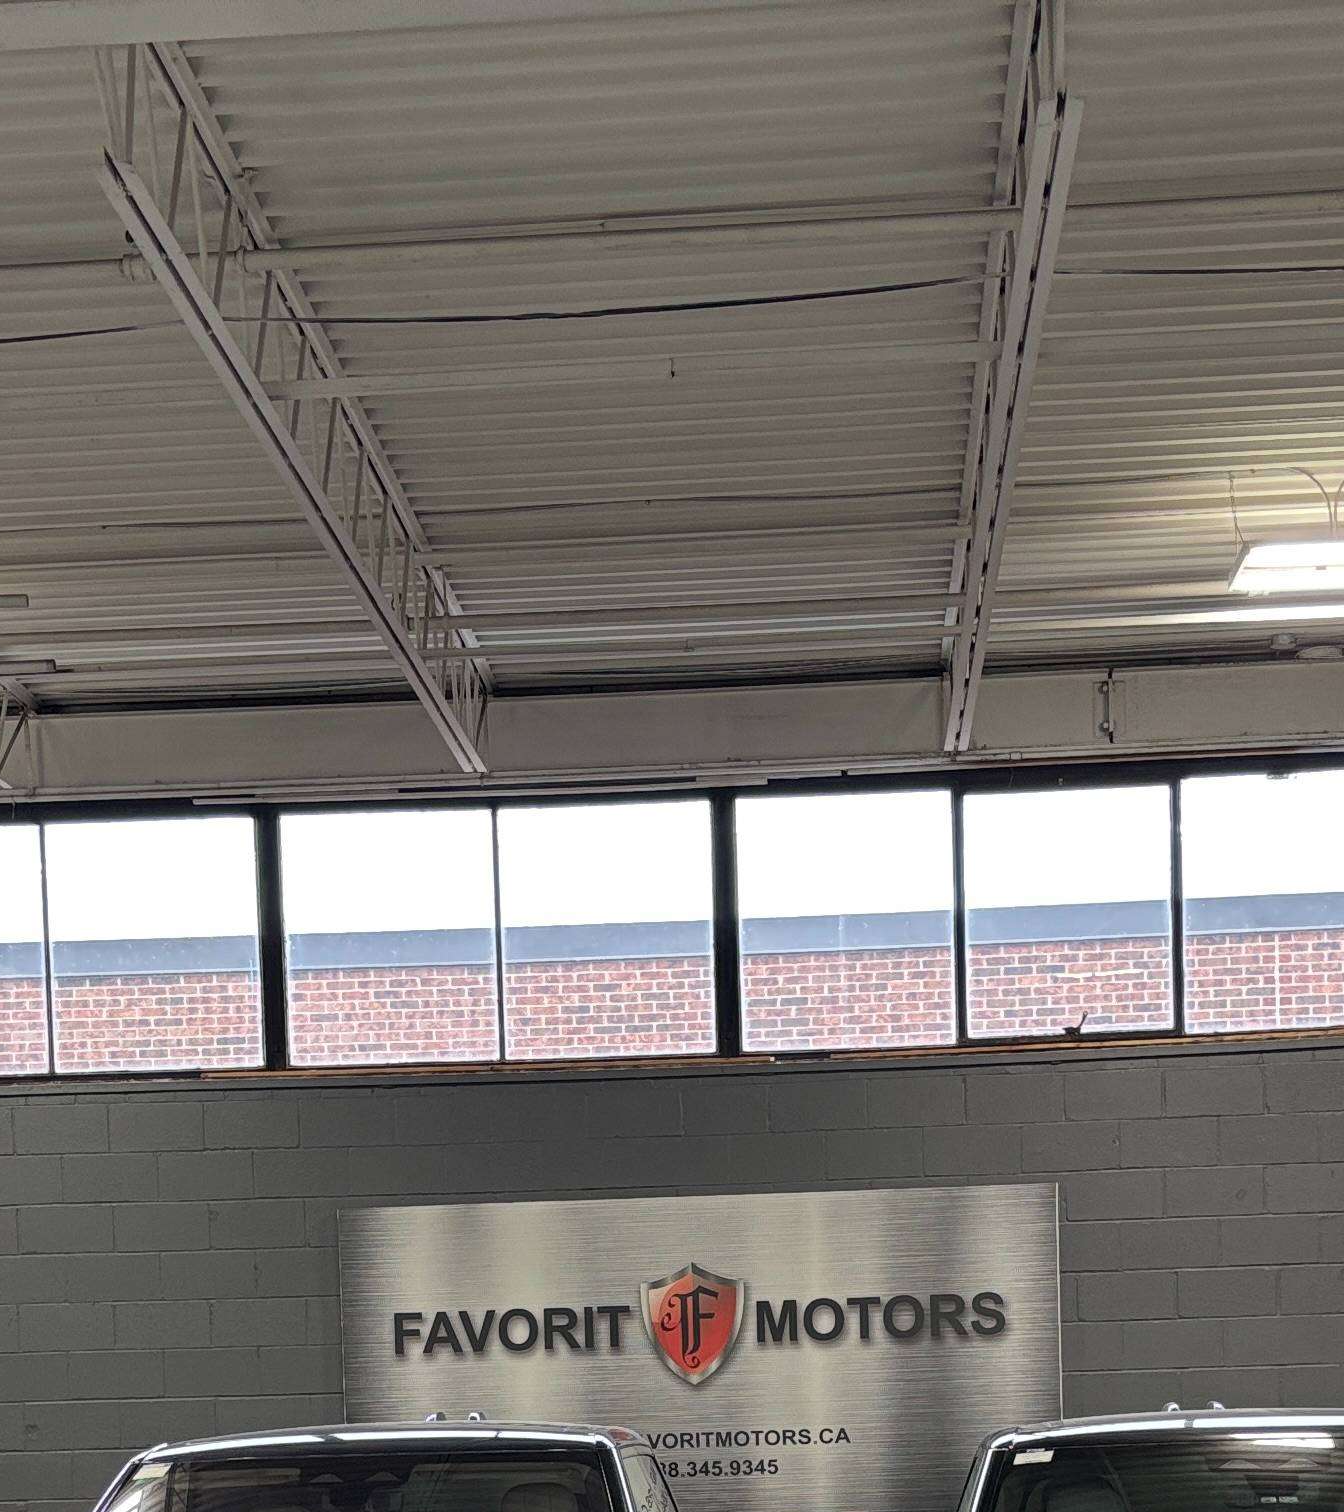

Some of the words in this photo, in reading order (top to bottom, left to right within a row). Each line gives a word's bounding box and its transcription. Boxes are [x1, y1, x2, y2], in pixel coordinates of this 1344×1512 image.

[393, 1304, 630, 1355] FAVORIT
[757, 1291, 1006, 1344] MOTORS
[647, 1427, 851, 1450] VORITMOTORS.CA
